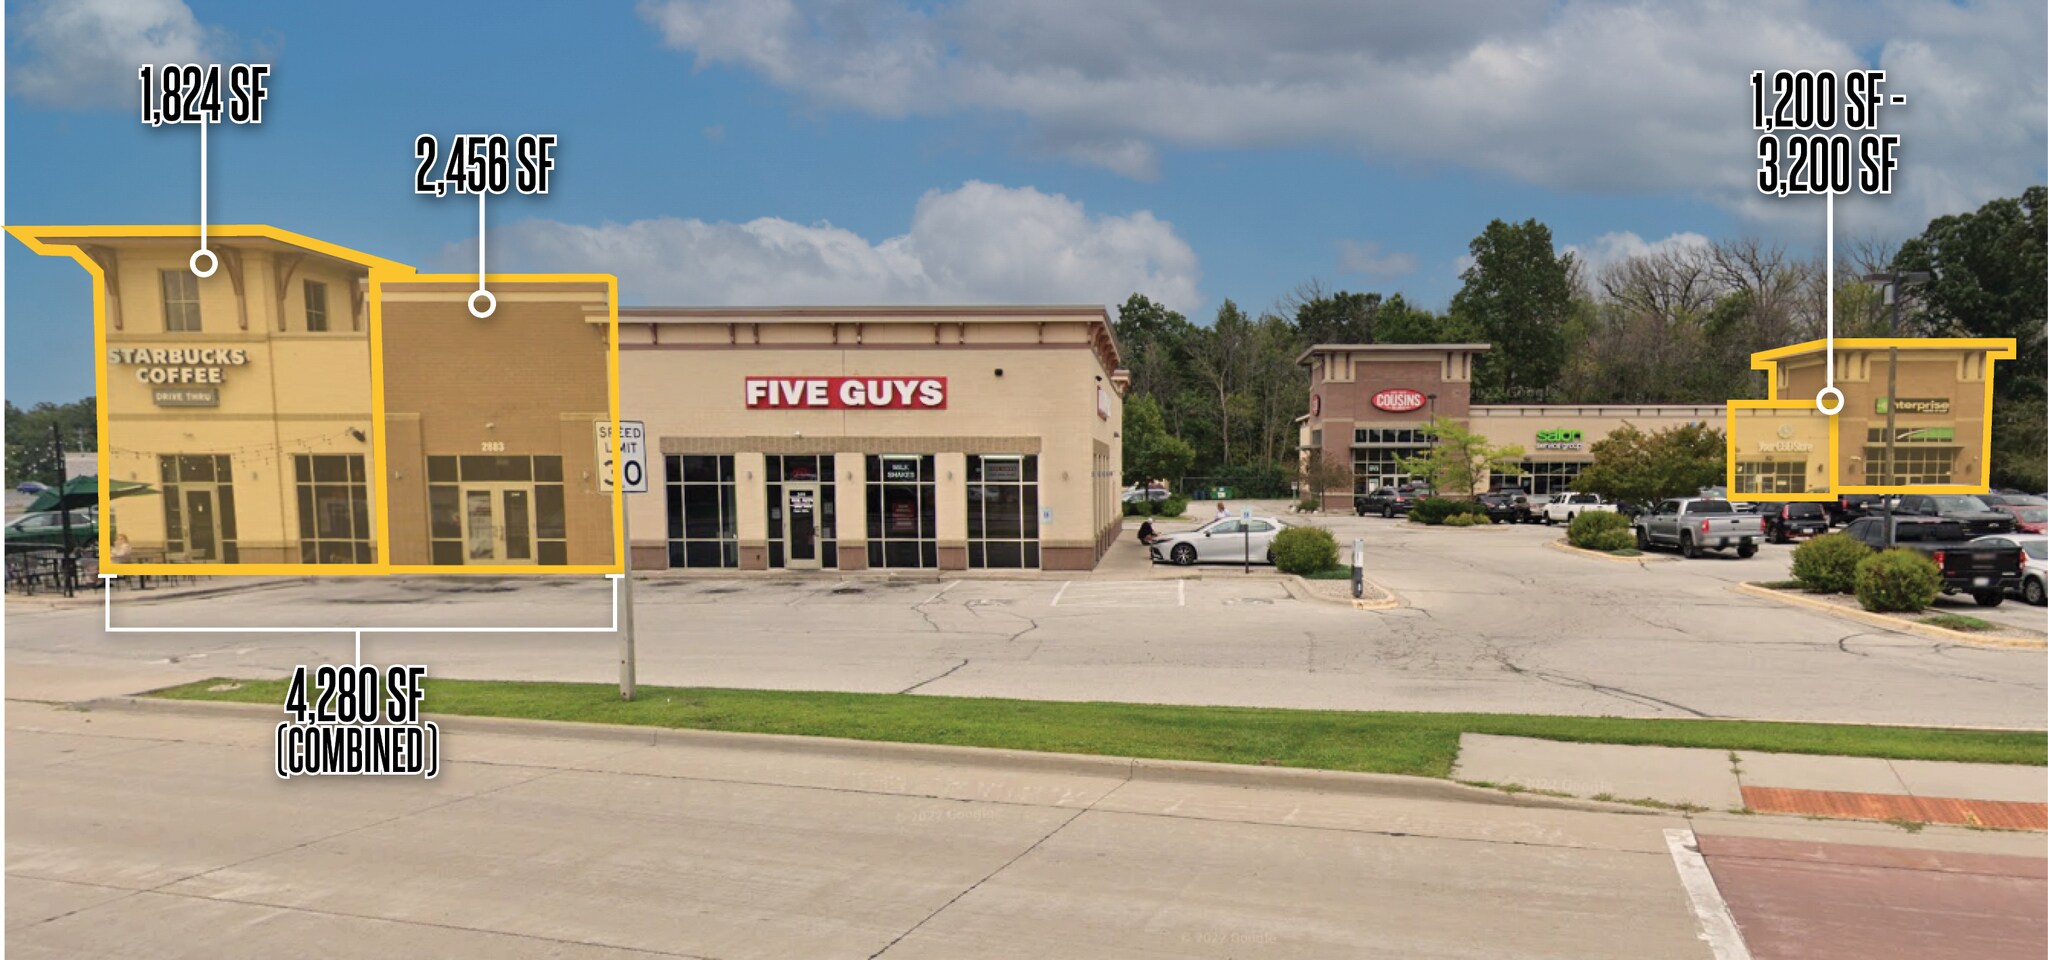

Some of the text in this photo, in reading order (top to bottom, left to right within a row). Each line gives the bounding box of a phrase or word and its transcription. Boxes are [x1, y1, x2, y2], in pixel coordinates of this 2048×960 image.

[109, 348, 245, 364] STARBUCKS
[135, 367, 222, 383] COFFEE
[155, 391, 212, 401] DRIVE THRU
[746, 379, 944, 406] FIVE GUYS
[1376, 393, 1421, 406] COUSINS
[1536, 429, 1583, 442] salon
[605, 442, 637, 453] LMIT
